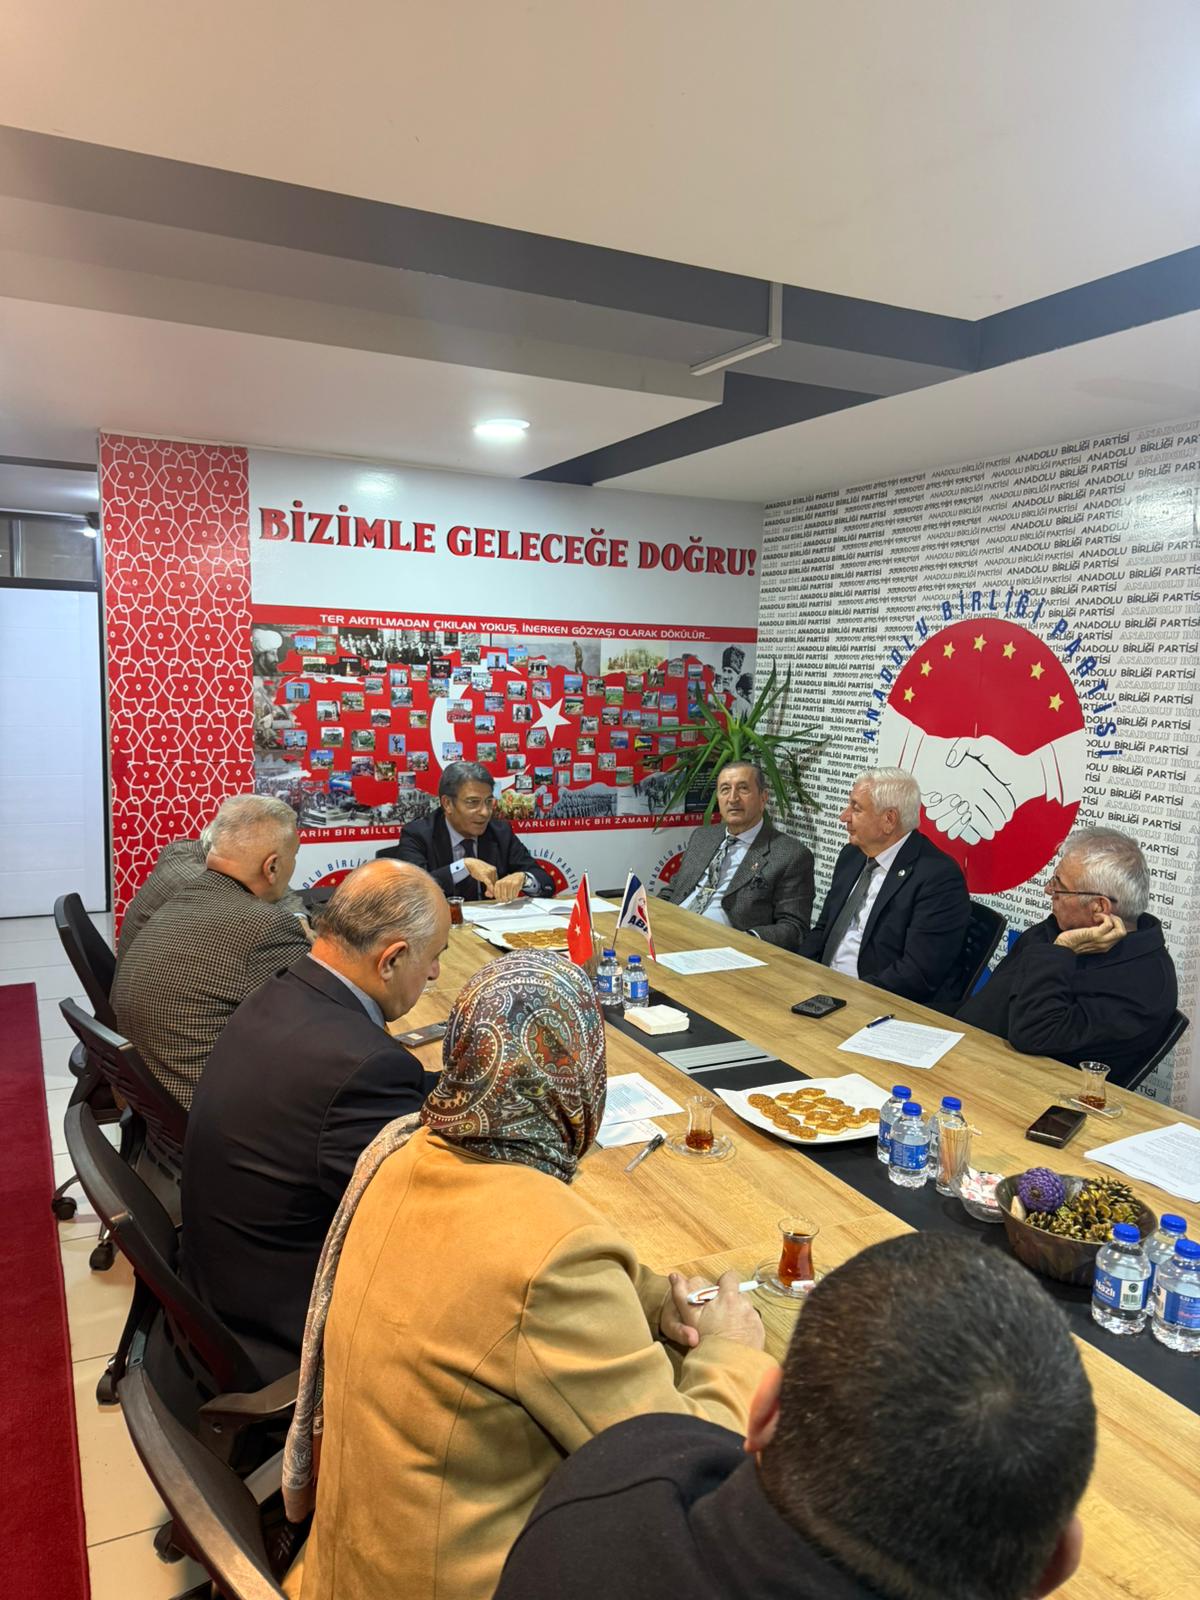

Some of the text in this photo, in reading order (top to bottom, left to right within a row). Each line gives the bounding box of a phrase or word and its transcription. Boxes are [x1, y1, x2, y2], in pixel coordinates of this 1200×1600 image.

[1015, 433, 1130, 464] ANADOLU BİRLİĞİ PARTİSİ
[1087, 438, 1174, 462] ANADOLU BİRLİĞİ
[1013, 458, 1128, 486] ANADOLU BİRLİĞİ PARTİSİ
[1085, 464, 1171, 486] ANADOLU BİRLİĞİ
[1012, 483, 1126, 508] ANADOLU BİRLİĞİ PARTİSİ
[765, 500, 791, 509] ANADOLU
[805, 502, 834, 511] ANADOLU
[764, 518, 790, 526] ANADOLU
[804, 520, 832, 529] ANADOLU
[1010, 519, 1052, 531] ANADOLU
[1056, 513, 1084, 525] BİRLİĞİ
[258, 500, 757, 576] BİZİMLE GELECEĞE DOĞRU!
[763, 535, 789, 543] ANADOLU
[803, 538, 831, 546] ANADOLU
[1008, 532, 1121, 553] ANADOLU BİRLİĞİ PARTİSİ
[1079, 541, 1164, 558] ANADOLU BİRLİĞİ
[1007, 557, 1119, 575] ANADOLU BİRLİĞİ PARTİSİ
[1077, 566, 1162, 581] ANADOLU BİRLİĞİ
[1050, 581, 1117, 594] BİRLİĞİ PARTİSİ
[1075, 592, 1159, 605] ANADOLU BİRLİĞİ
[1048, 606, 1115, 617] BİRLİĞİ PARTİSİ
[320, 614, 344, 624] TER
[349, 616, 429, 628] AKITILMADAN
[434, 620, 476, 630] ÇIKILAN
[523, 623, 568, 634] İNERKEN
[572, 626, 615, 638] GÖZYAŞI
[619, 629, 657, 638] OLARAK
[1125, 617, 1157, 627] BİRLİĞİ
[1123, 642, 1198, 652] BİRLİĞİ PARTİSİ
[864, 586, 1122, 756] ANADOLU BİRLİĞİ PARTİSİ
[1121, 667, 1196, 677] BİRLİĞİ PARTİSİ
[1119, 691, 1194, 703] BİRLİĞİ PARTİSİ
[1116, 715, 1191, 729] BİRLİĞİ PARTİSİ
[1114, 739, 1189, 754] BİRLİĞİ PARTİSİ
[1112, 763, 1186, 780] BİRLİĞİ PARTİSİ
[1110, 787, 1184, 805] BİRLİĞİ PARTİSİ
[518, 819, 571, 828] VARLIĞINI
[575, 817, 590, 827] HİÇ
[595, 817, 611, 825] BİR
[615, 816, 648, 824] ZAMAN
[1108, 811, 1181, 830] BİRLİĞİ PARTİSİ
[1140, 842, 1179, 855] PARTİSİ
